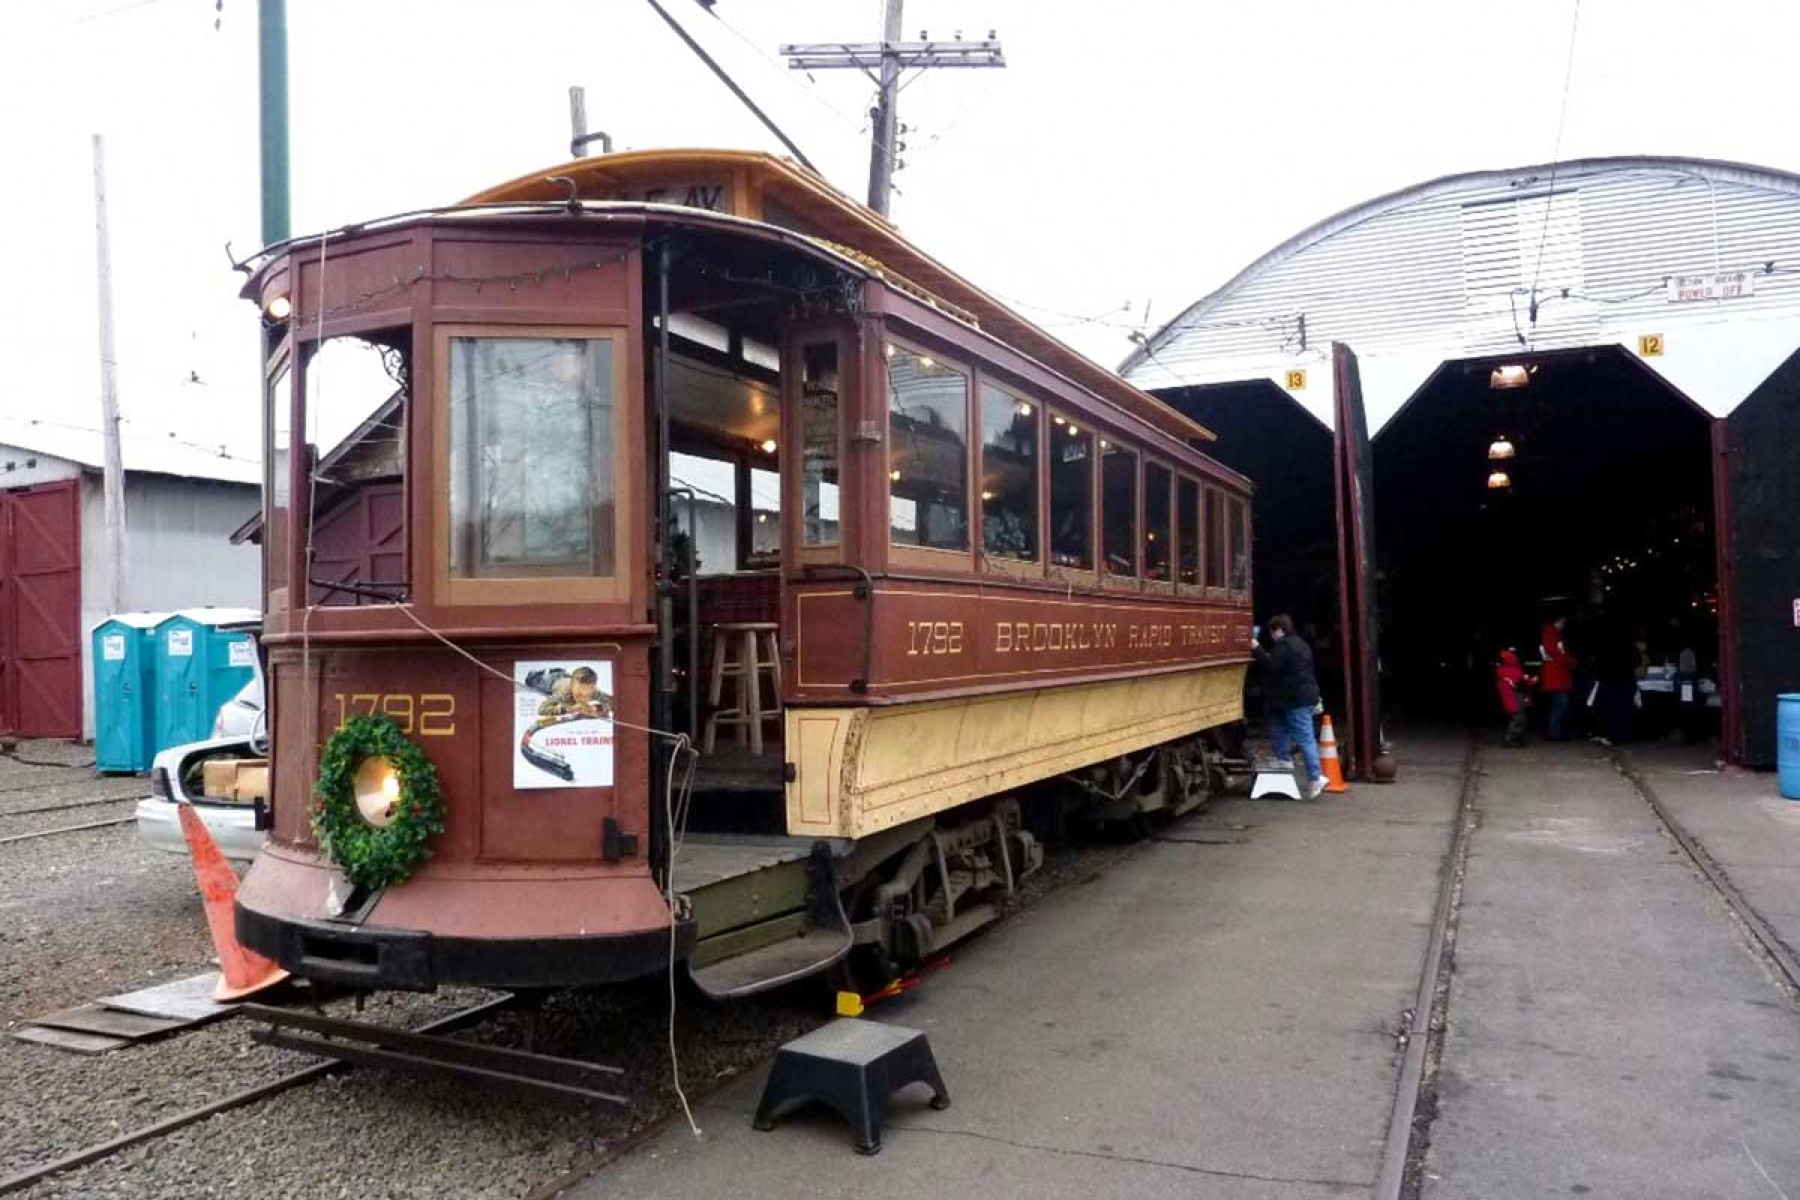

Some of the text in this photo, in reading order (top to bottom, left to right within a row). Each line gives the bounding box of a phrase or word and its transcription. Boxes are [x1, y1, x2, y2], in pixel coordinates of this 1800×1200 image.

[1643, 337, 1659, 353] 12
[1289, 372, 1303, 387] 13
[907, 621, 963, 655] 1792
[995, 622, 1117, 652] BROOKLYN
[1128, 625, 1172, 648] RAPID
[335, 693, 456, 736] 1792
